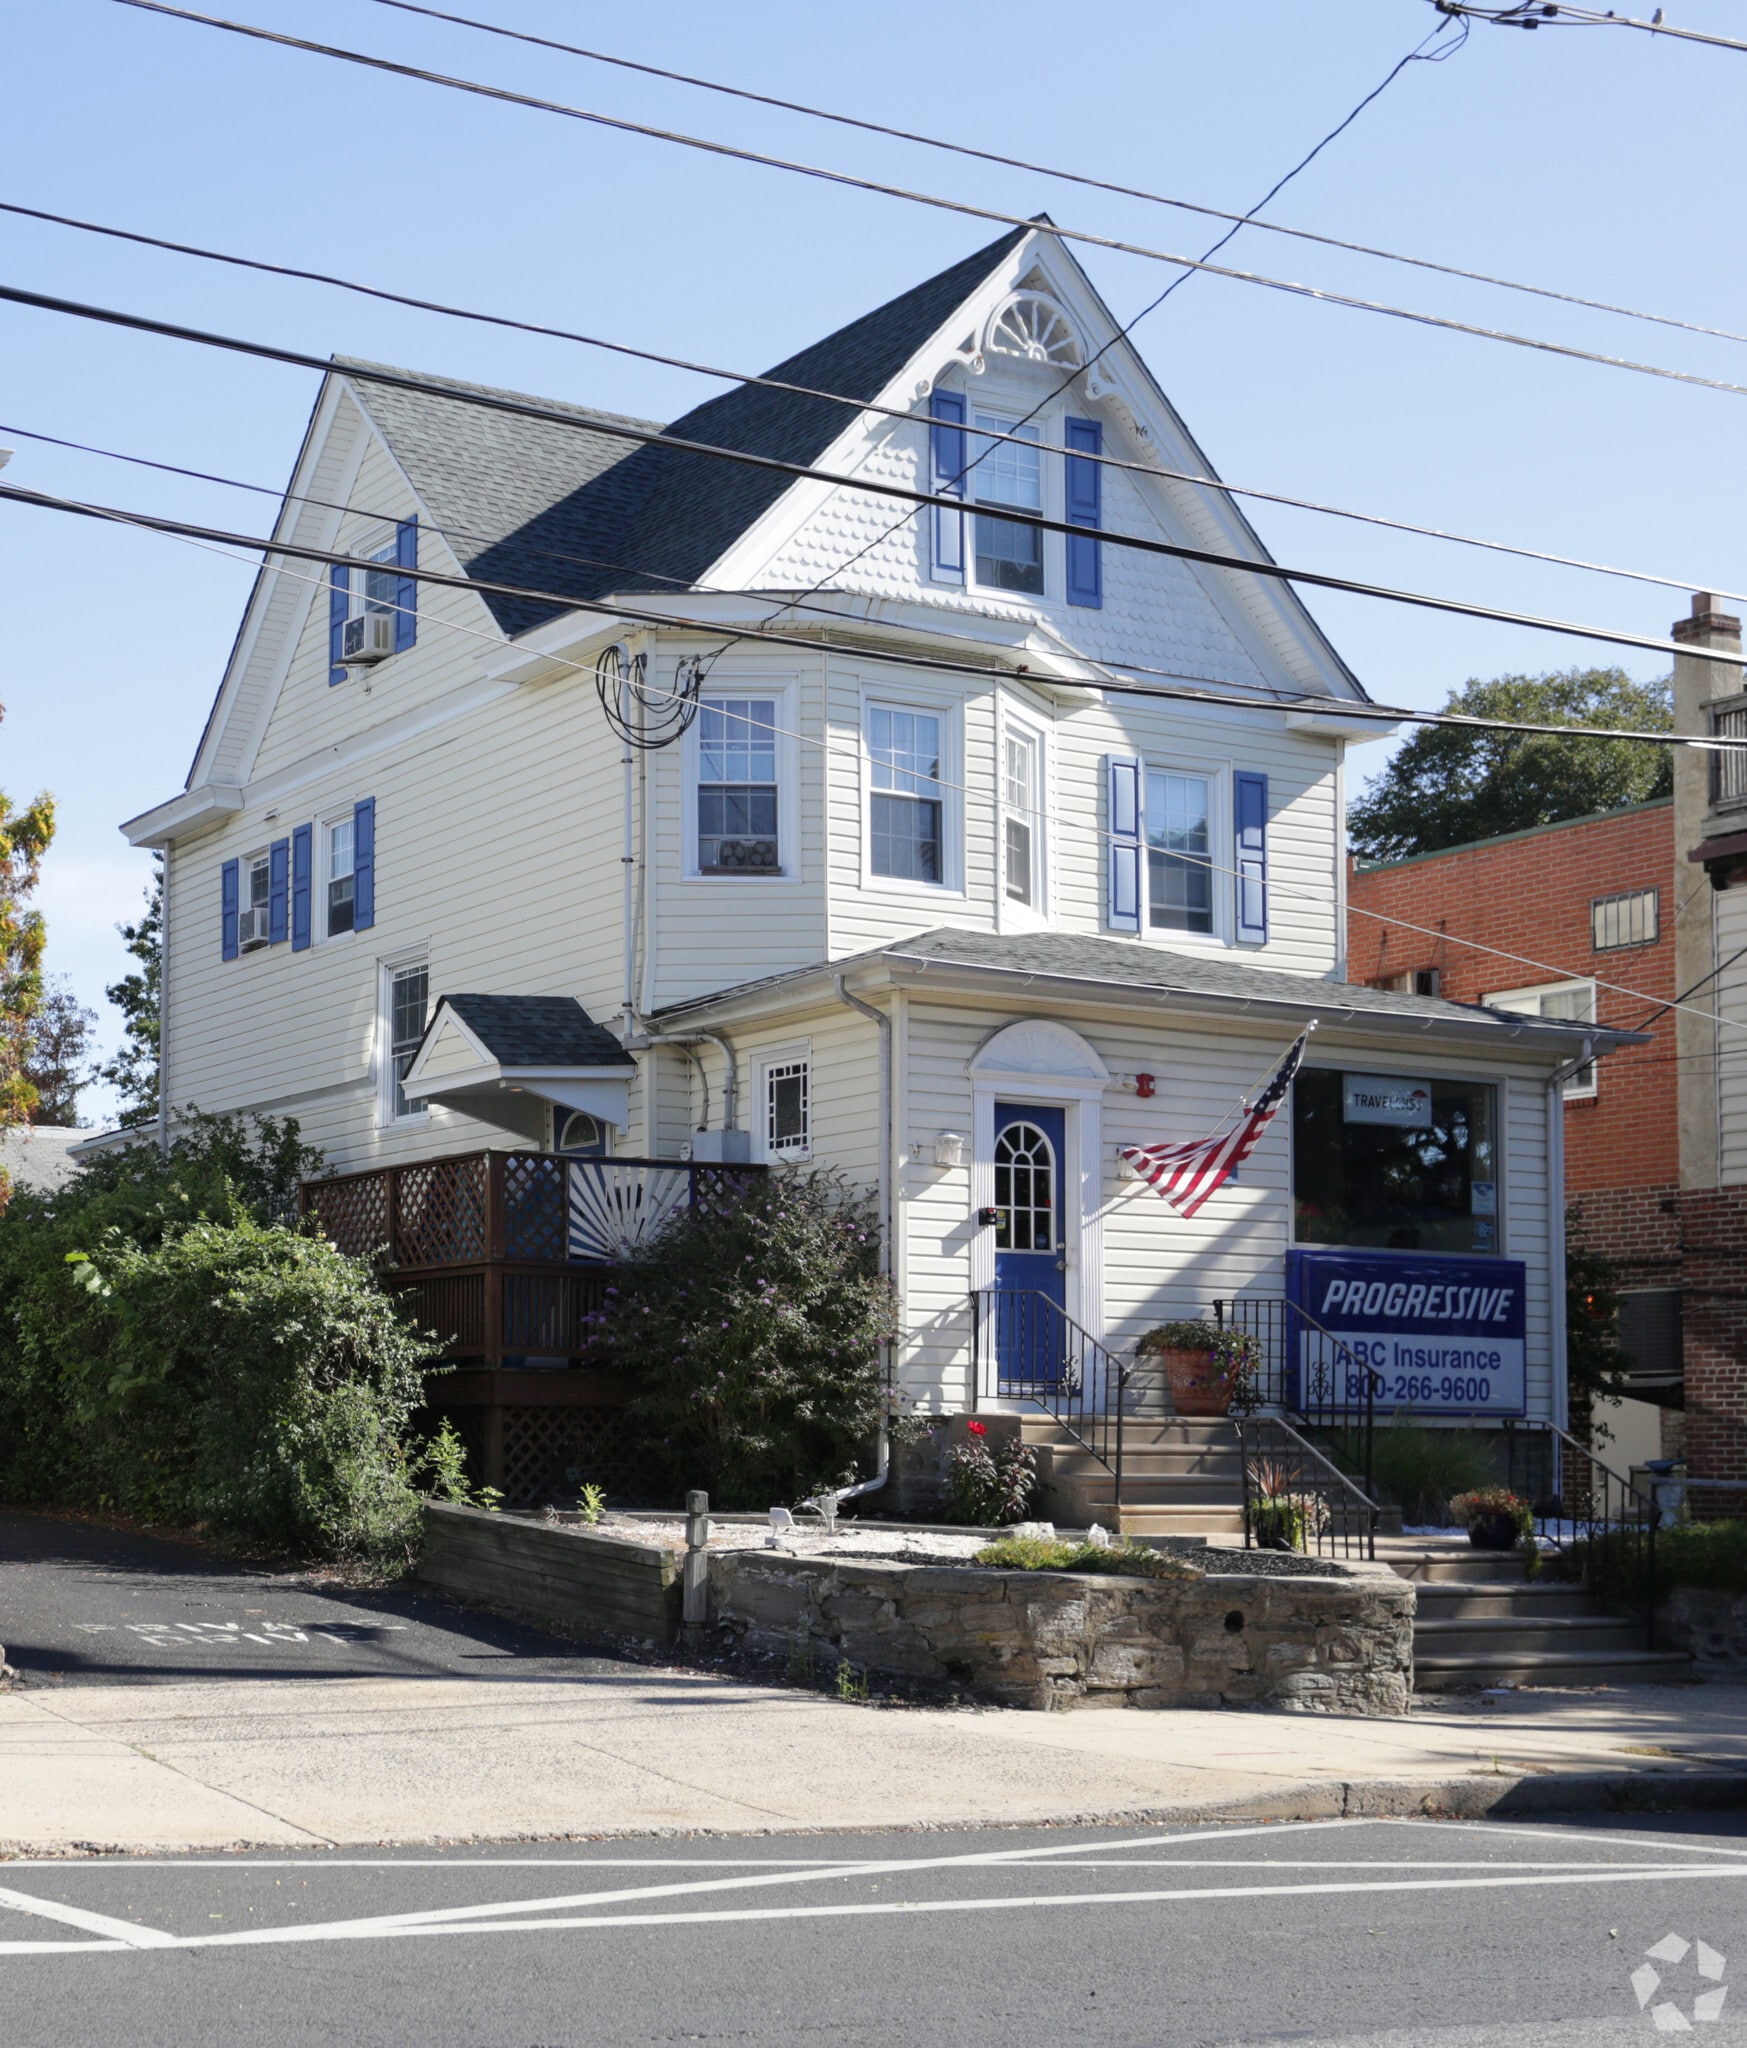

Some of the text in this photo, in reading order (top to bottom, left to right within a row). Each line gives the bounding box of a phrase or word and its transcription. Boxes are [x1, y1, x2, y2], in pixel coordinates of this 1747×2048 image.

[1321, 1280, 1514, 1321] PROGRESSIVE
[1336, 1341, 1501, 1370] ABC Insurance
[138, 1632, 378, 1646] DRIVE
